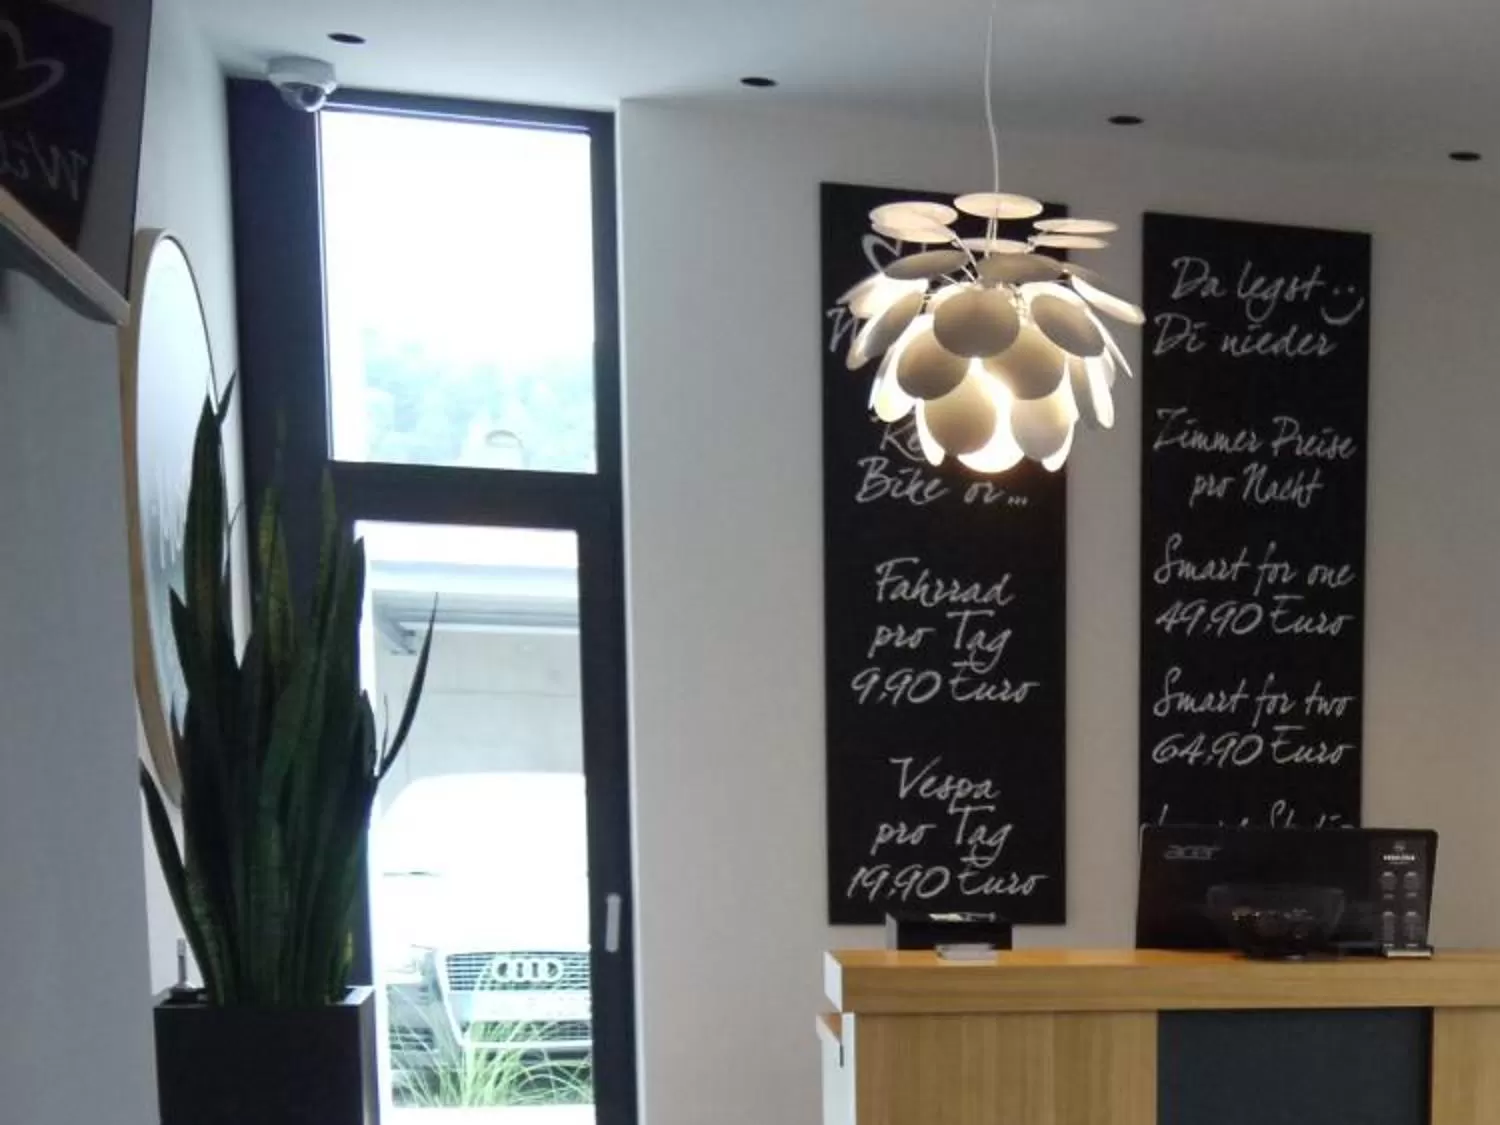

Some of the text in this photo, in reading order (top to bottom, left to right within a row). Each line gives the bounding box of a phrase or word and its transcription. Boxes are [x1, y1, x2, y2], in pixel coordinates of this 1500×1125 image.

[1171, 256, 1327, 322] Da legst
[1153, 312, 1338, 357] Di nieder
[1153, 406, 1358, 459] Zimmer Preise
[855, 457, 950, 505] Bike
[1188, 462, 1325, 508] pro Nacht
[874, 556, 1017, 608] Fahrrad
[1153, 532, 1356, 597] Smart for one
[1269, 595, 1355, 634] Euro
[866, 608, 1013, 674] pro Tag
[949, 660, 1041, 704] Euro
[1153, 666, 1356, 729] Smart for two
[1270, 725, 1356, 765] Euro
[888, 755, 1000, 815] Vespa
[869, 804, 1013, 868] pro Tag
[957, 856, 1049, 897] Euro
